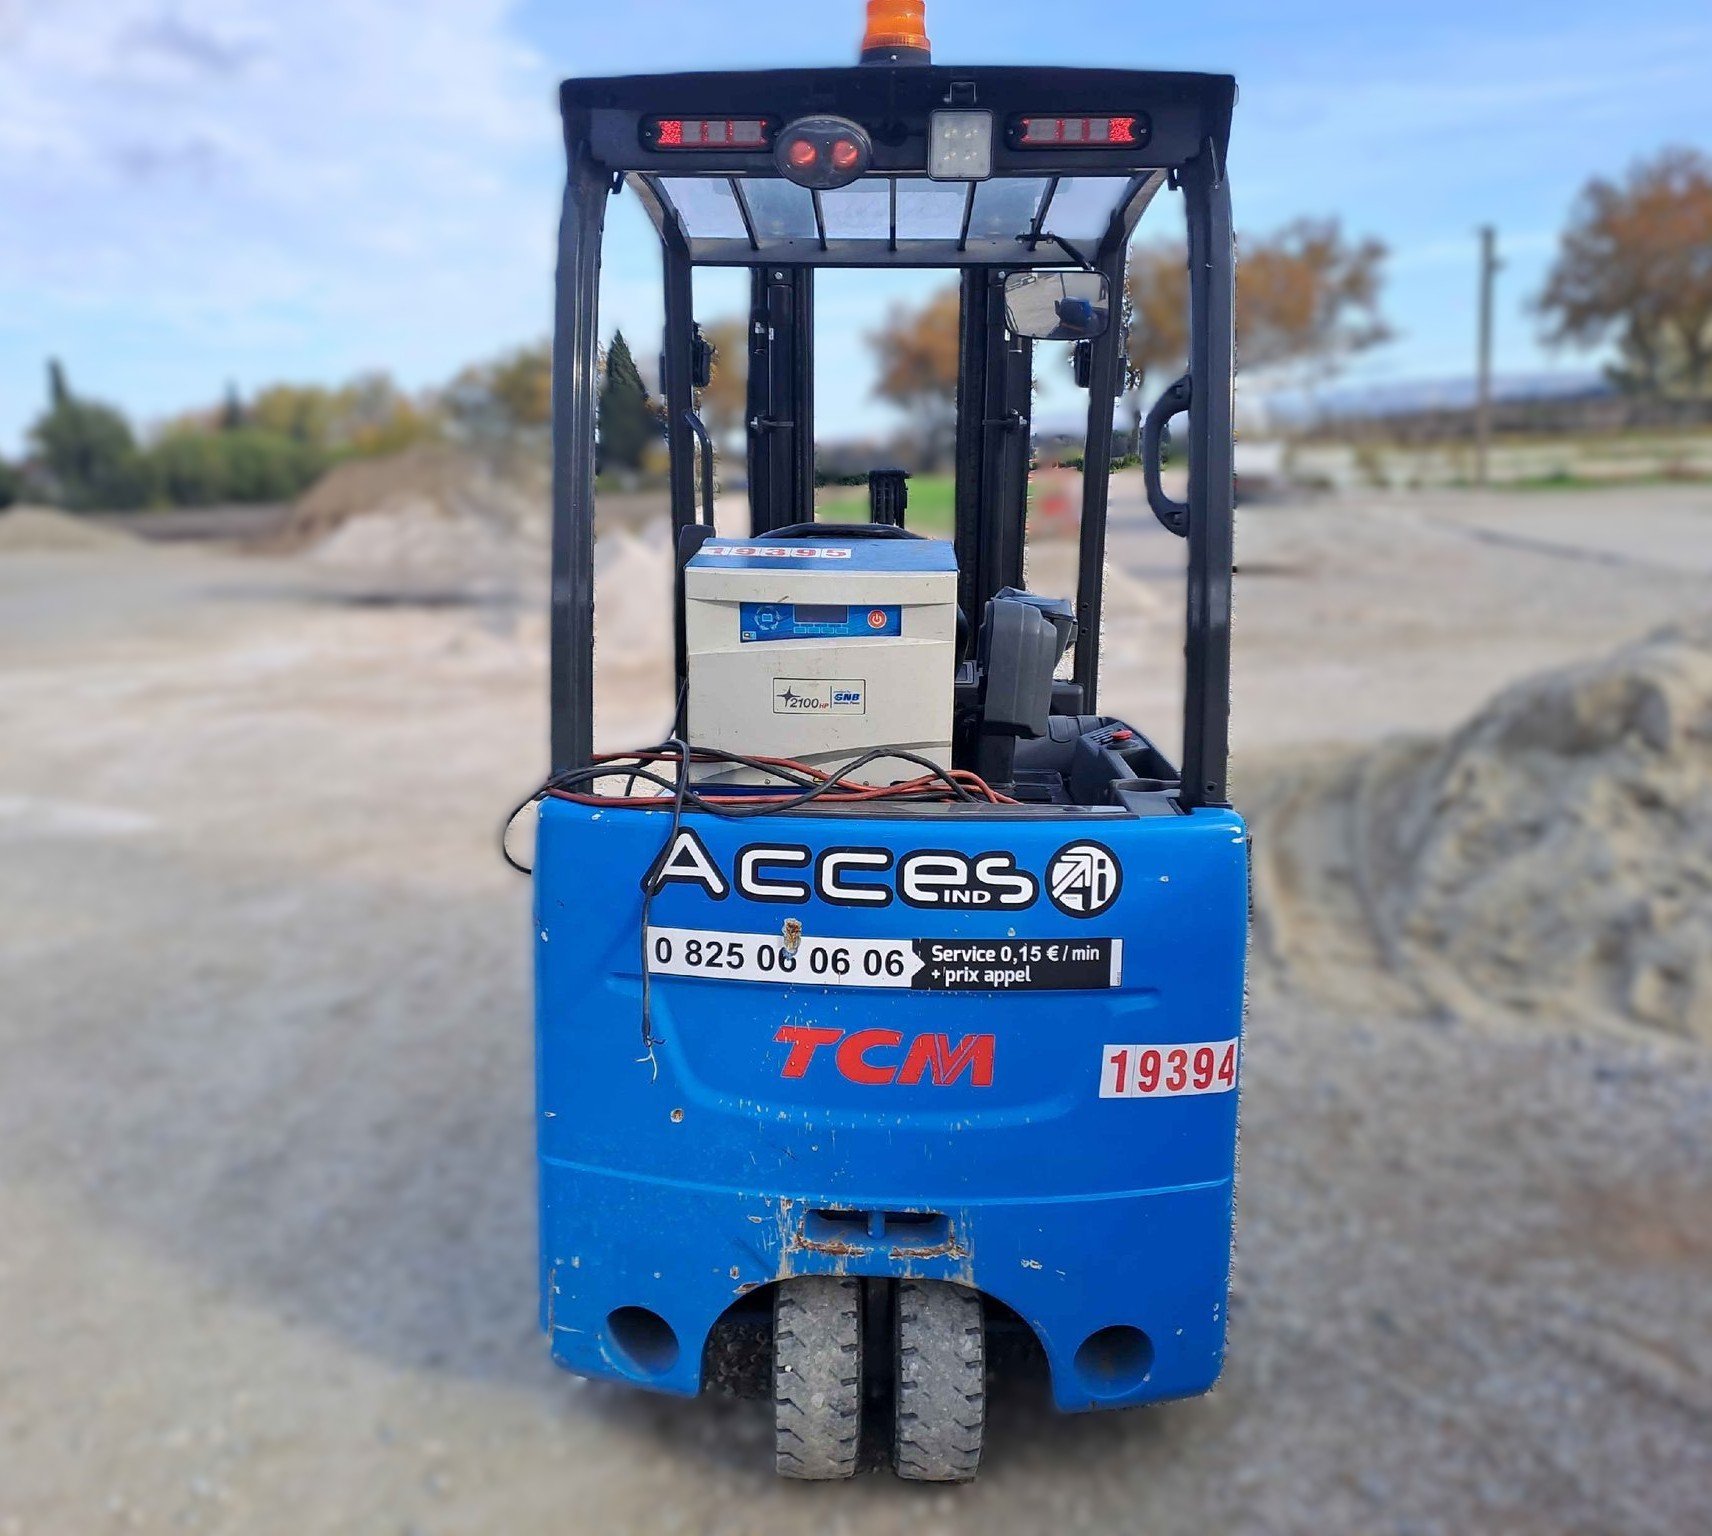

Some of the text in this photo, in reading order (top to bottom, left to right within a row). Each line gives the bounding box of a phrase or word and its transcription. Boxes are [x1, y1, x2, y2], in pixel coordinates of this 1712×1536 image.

[709, 547, 847, 557] 19395
[789, 698, 819, 709] 2100
[833, 693, 860, 701] GNB
[943, 890, 991, 904] IND
[655, 937, 672, 963] 0
[685, 939, 745, 970] 825
[810, 947, 850, 976] 06
[863, 949, 905, 977] 06
[931, 945, 996, 962] Service
[1000, 946, 1042, 965] 0,15
[1046, 946, 1060, 962] €
[1072, 945, 1100, 961] min
[945, 966, 979, 987] prix
[983, 965, 1032, 987] appel
[772, 1025, 996, 1087] TCM
[1110, 1043, 1236, 1093] 19394
